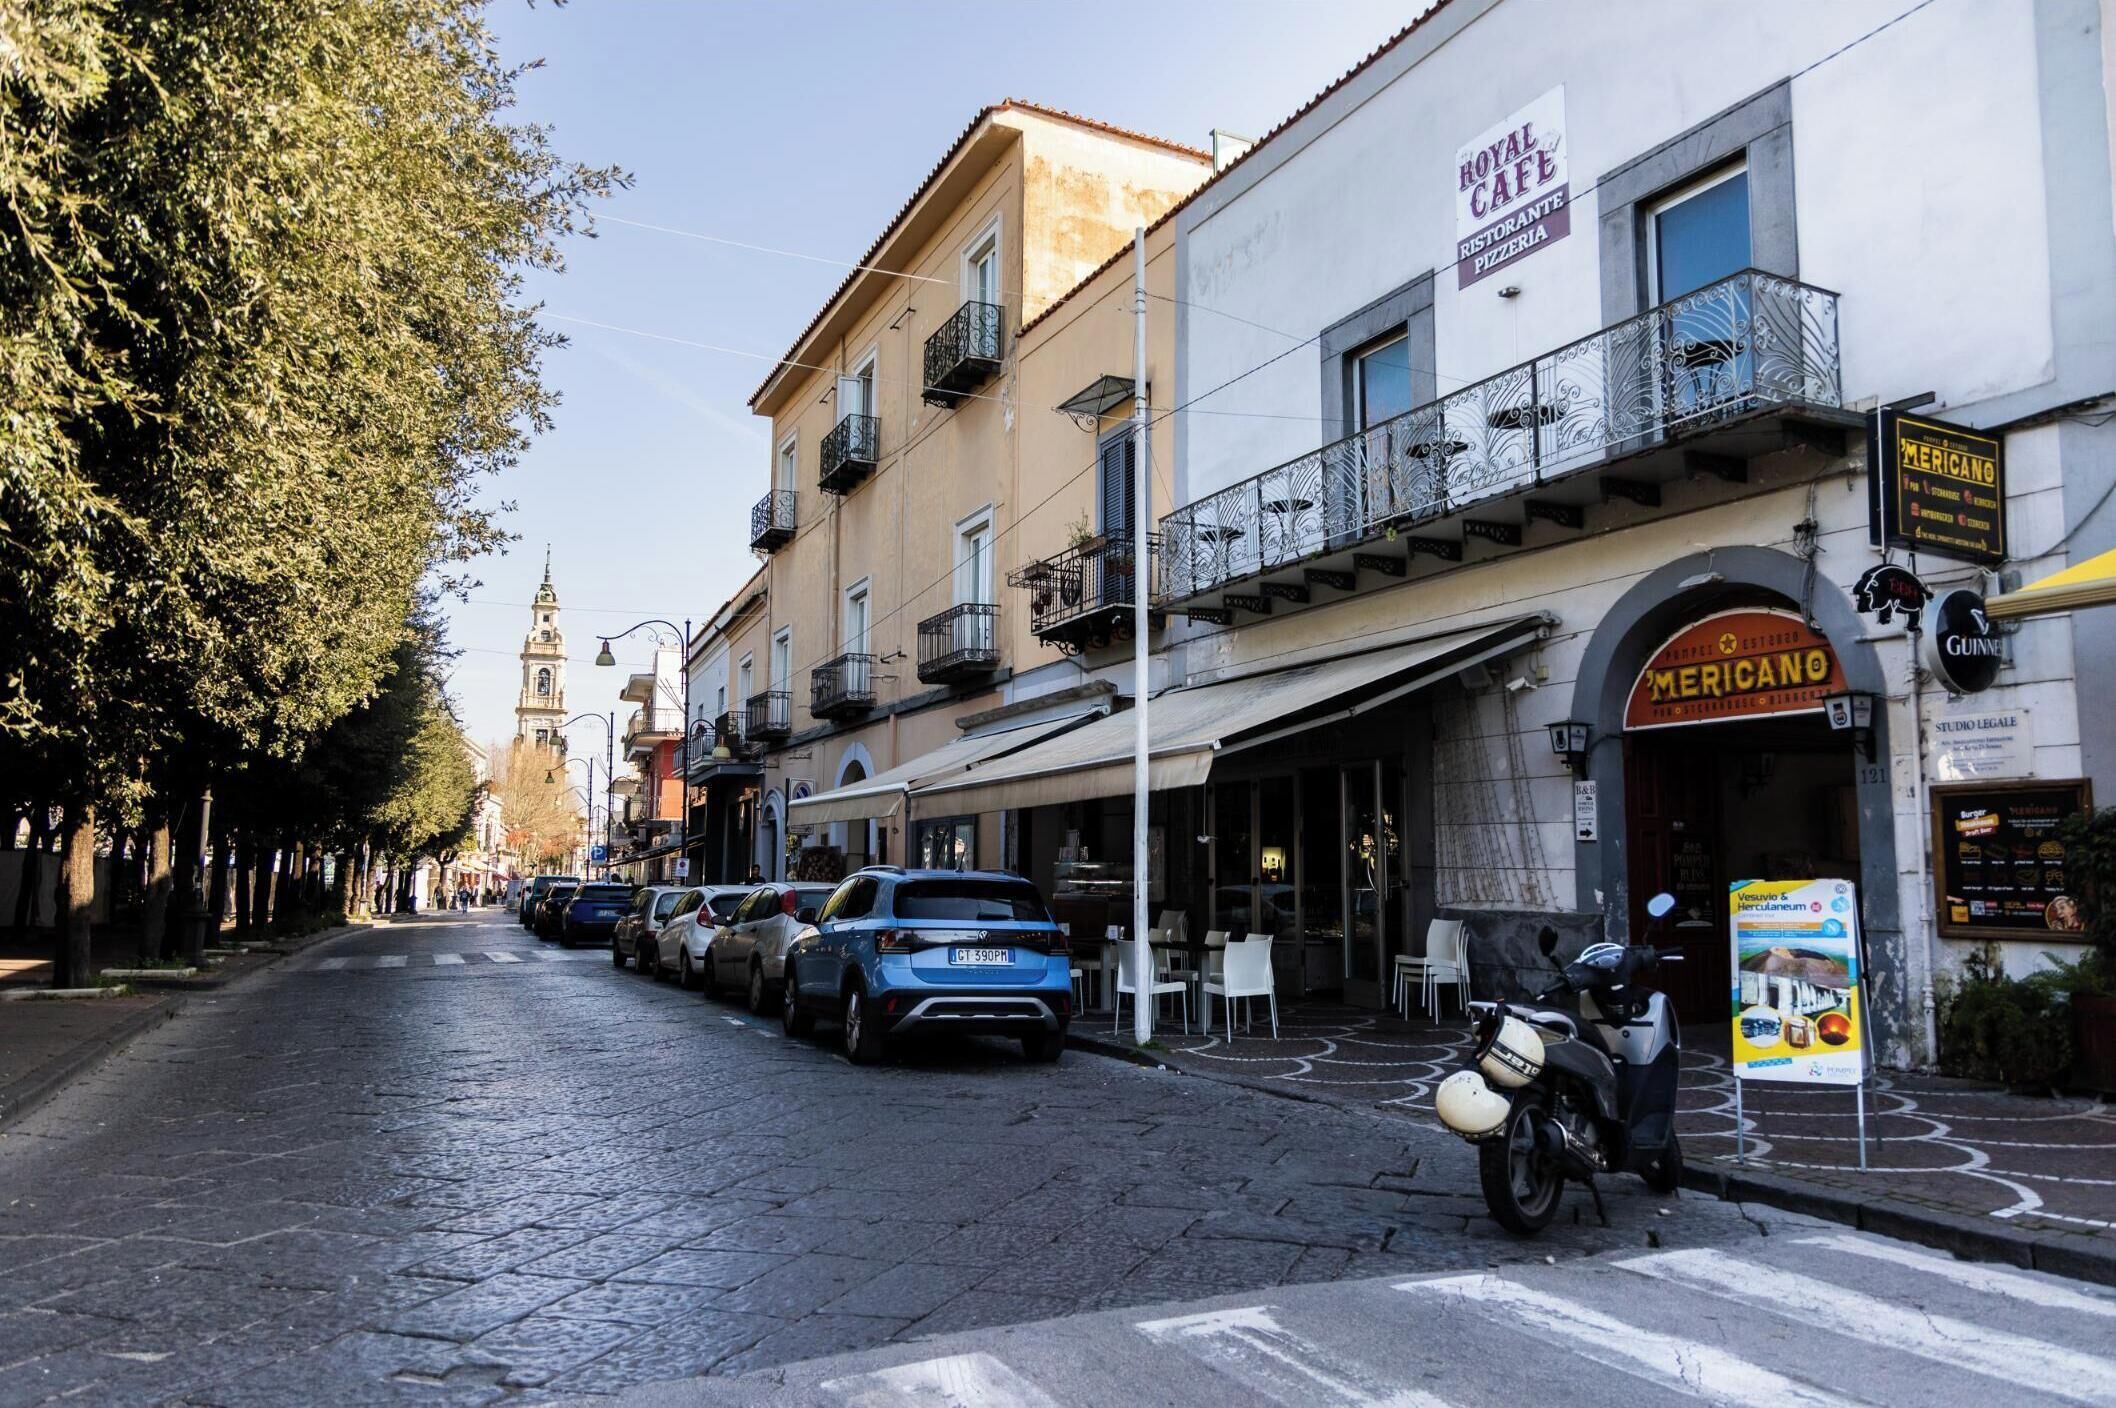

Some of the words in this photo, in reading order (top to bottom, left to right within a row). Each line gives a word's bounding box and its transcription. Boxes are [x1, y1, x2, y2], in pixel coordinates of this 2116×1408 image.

[1459, 121, 1538, 191] ROYAL
[1459, 191, 1565, 260] RISTORANTE
[1474, 225, 1549, 275] PIZZERIA
[1665, 645, 1713, 661] POMPEI
[1946, 635, 2001, 656] GUINNE
[1647, 649, 1829, 702] 'MERICANO
[1684, 697, 1756, 714] STEAKHOUSE
[1936, 720, 1975, 733] STUDIO
[1978, 716, 2017, 729] LEGALE
[1861, 768, 1887, 785] 121
[1576, 785, 1596, 795] B&B
[1960, 808, 1987, 820] Burger
[1738, 892, 1777, 901] Vesuvio
[1780, 892, 1789, 901] &
[1738, 901, 1807, 912] Herculaneum
[957, 949, 971, 962] GT
[975, 950, 1008, 962] 390PM
